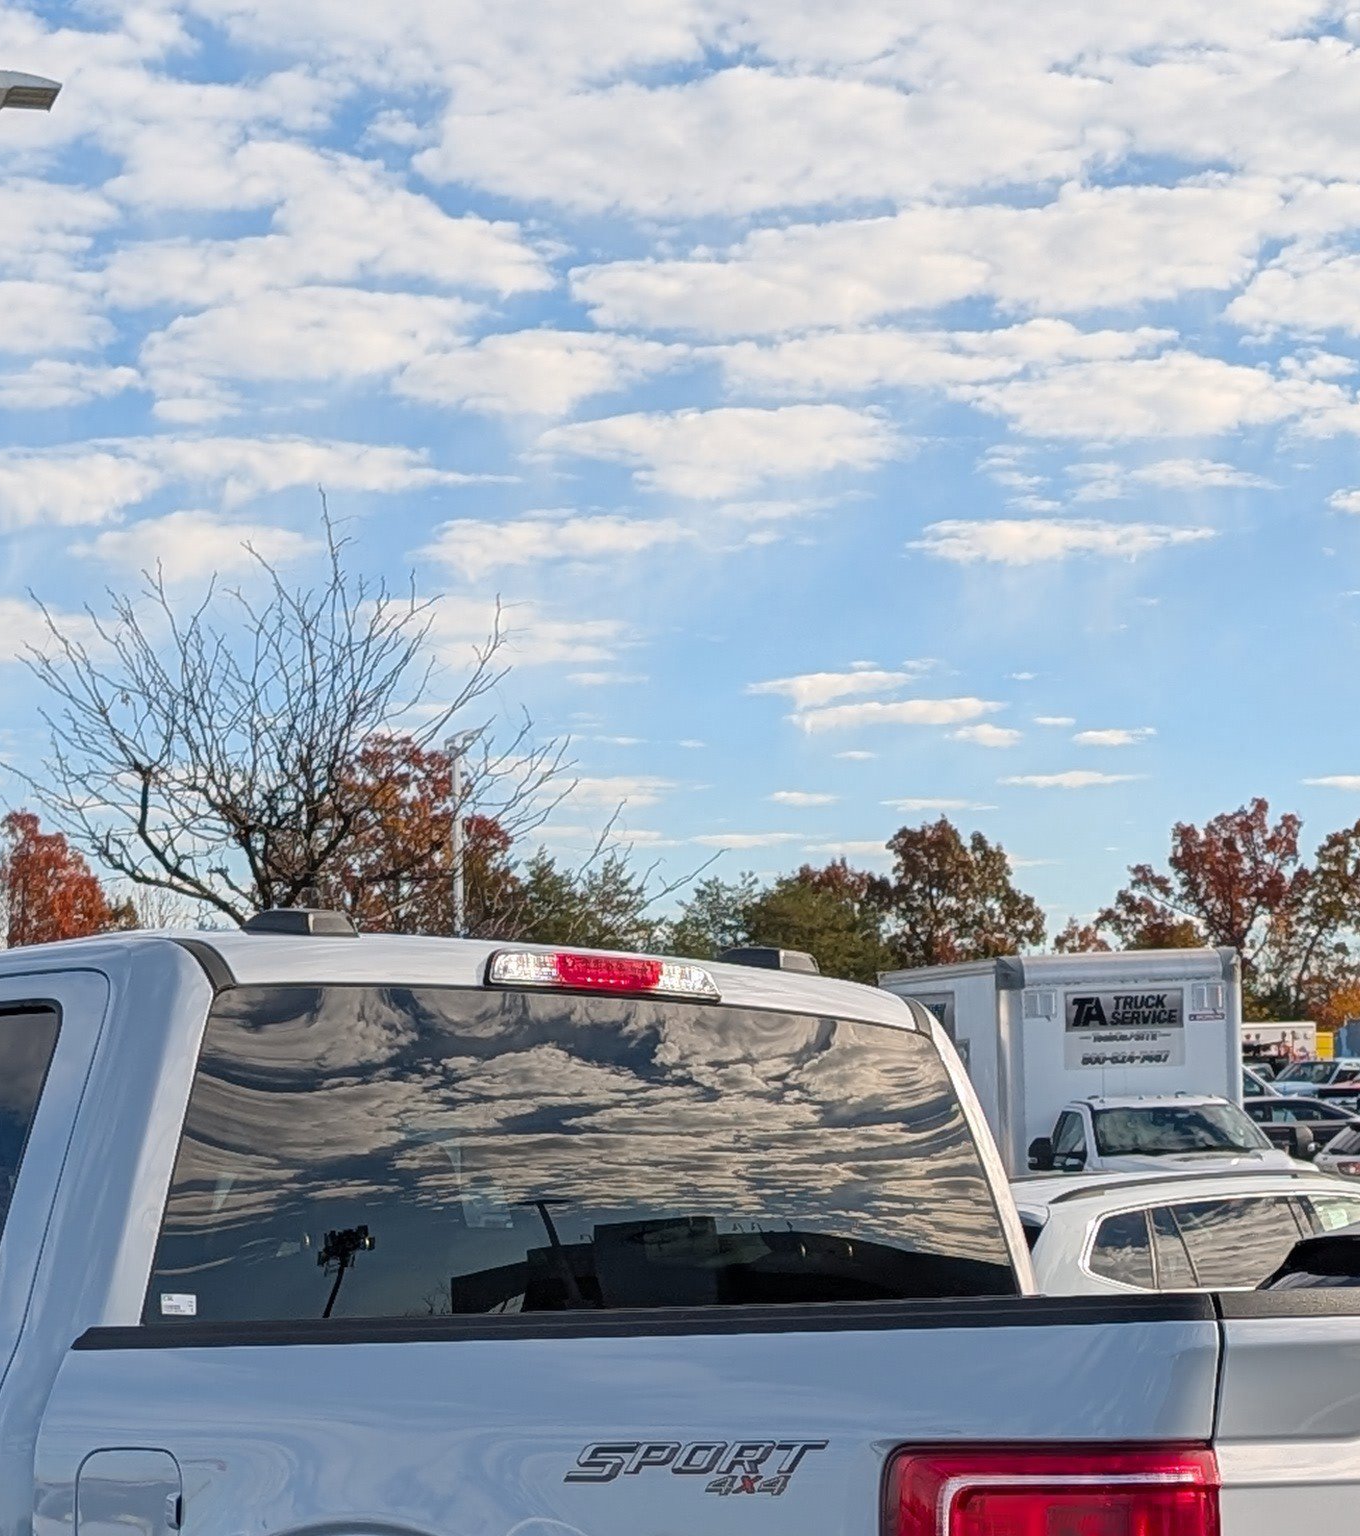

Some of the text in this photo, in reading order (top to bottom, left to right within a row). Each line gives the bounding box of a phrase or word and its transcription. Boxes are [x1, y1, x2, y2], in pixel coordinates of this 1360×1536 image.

[1072, 997, 1108, 1027] TA
[1113, 994, 1167, 1010] TRUCK
[1110, 1009, 1178, 1026] SERVICE
[563, 1440, 830, 1483] SPORT
